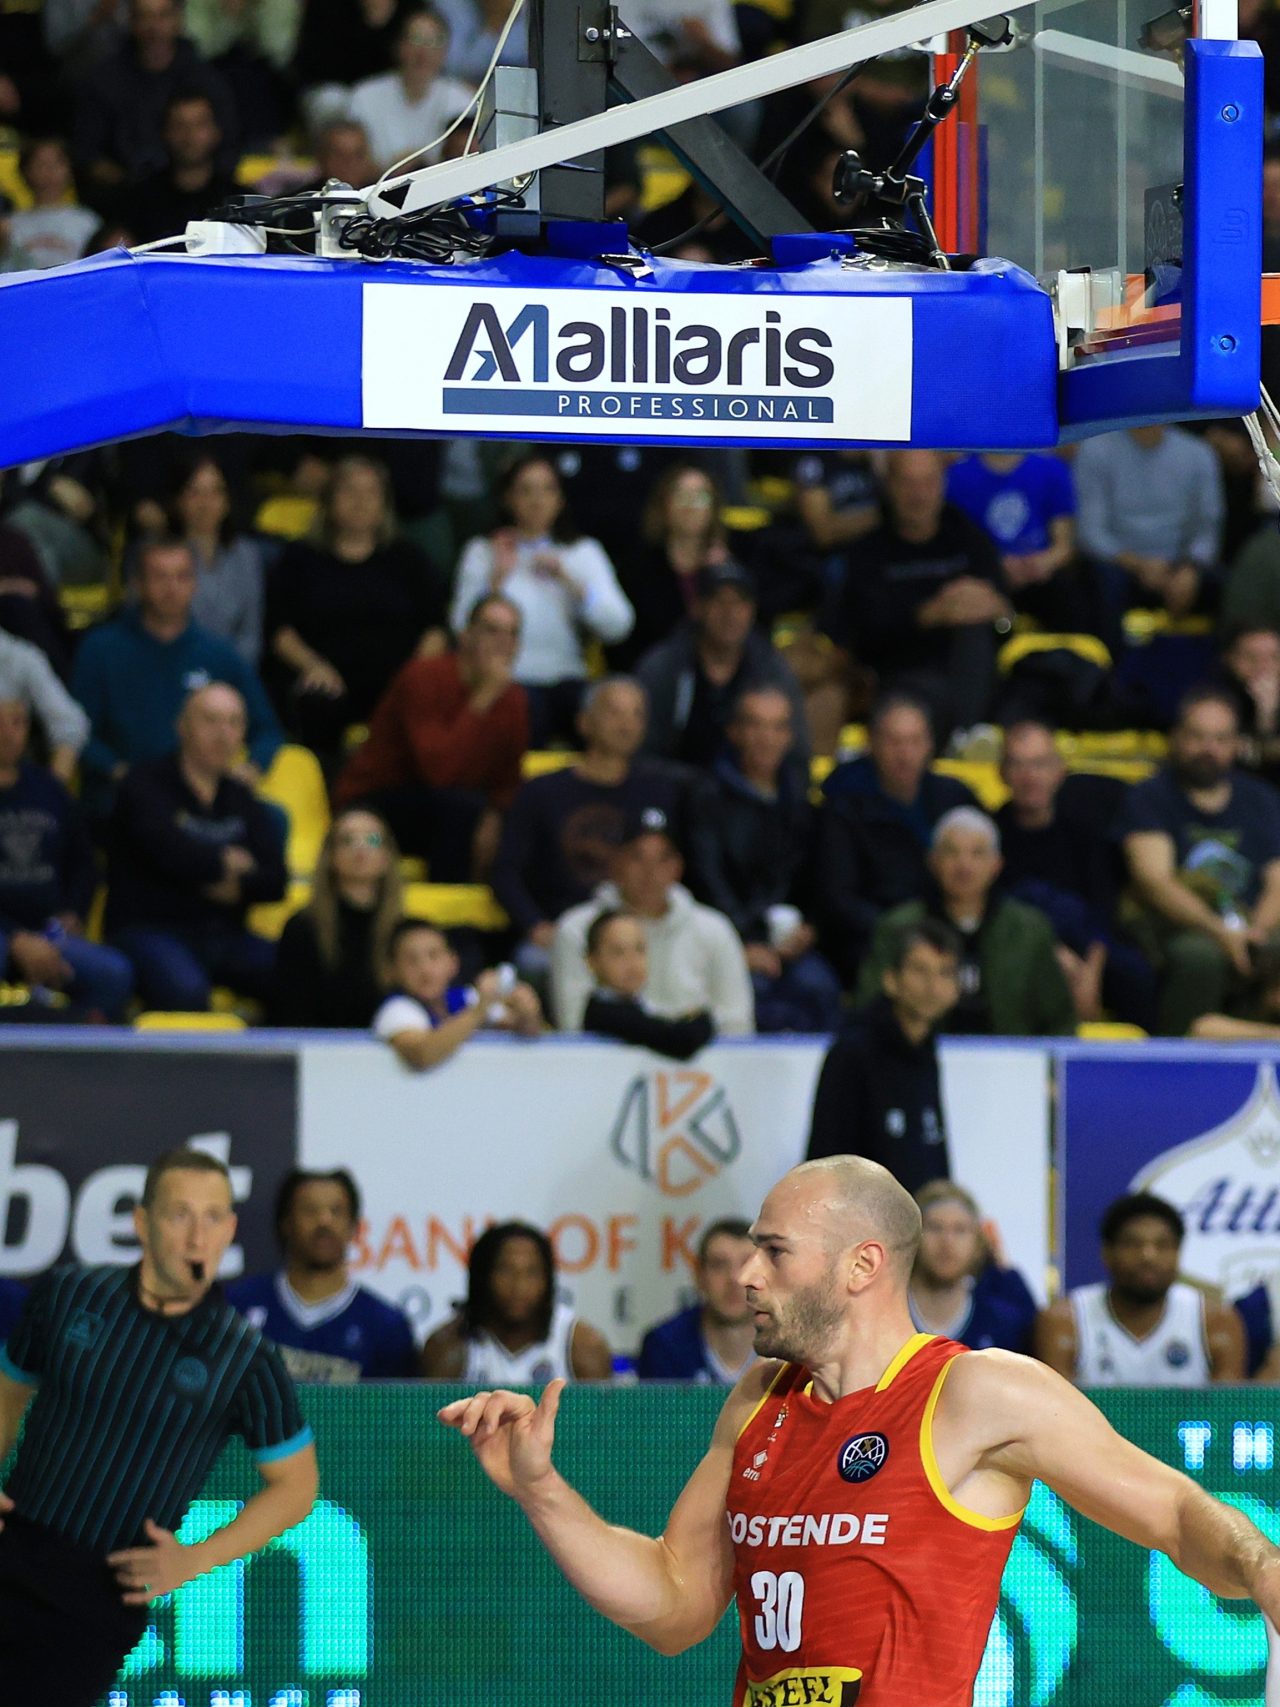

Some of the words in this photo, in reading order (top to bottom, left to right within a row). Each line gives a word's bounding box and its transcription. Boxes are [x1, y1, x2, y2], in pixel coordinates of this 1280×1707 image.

[558, 394, 819, 421] PROFESSIONAL
[548, 1214, 640, 1273] OF
[726, 1511, 889, 1547] OSTENDE
[750, 1571, 804, 1652] 30
